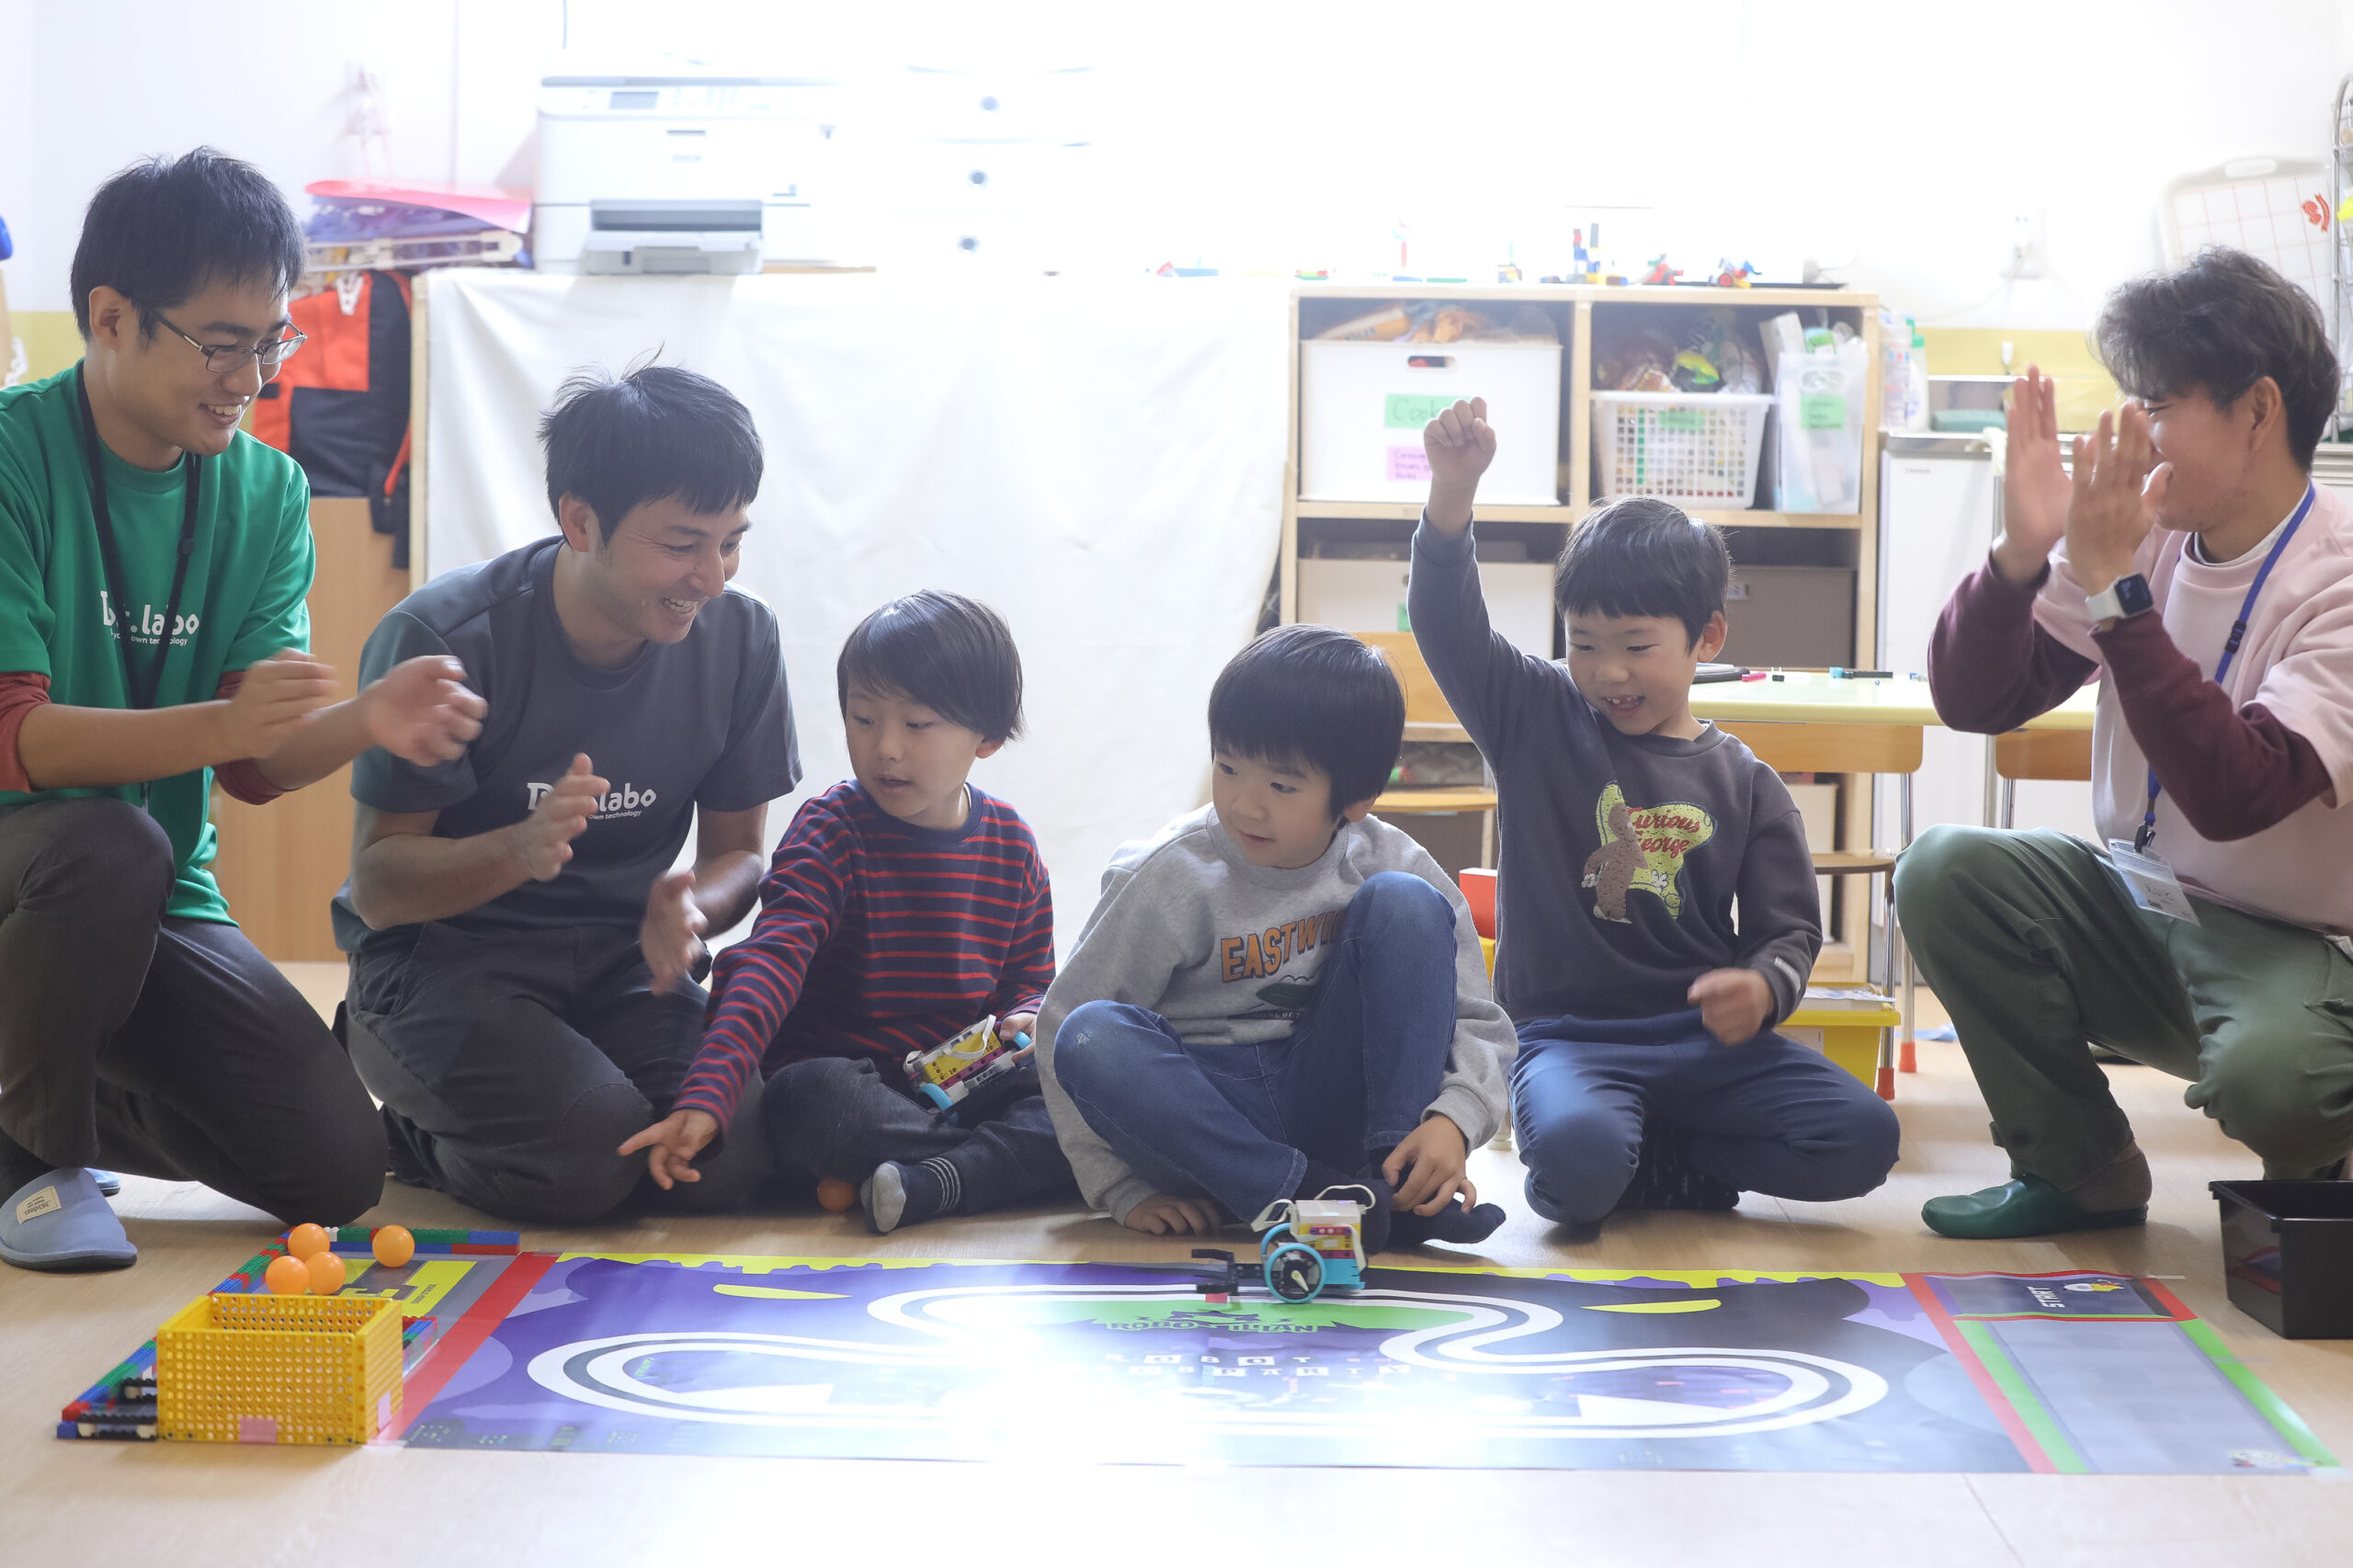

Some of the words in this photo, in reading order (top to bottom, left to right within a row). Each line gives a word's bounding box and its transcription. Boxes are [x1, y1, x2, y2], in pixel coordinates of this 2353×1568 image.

[149, 637, 188, 646] tecology
[605, 809, 642, 820] technology
[2027, 1286, 2066, 1309] START
